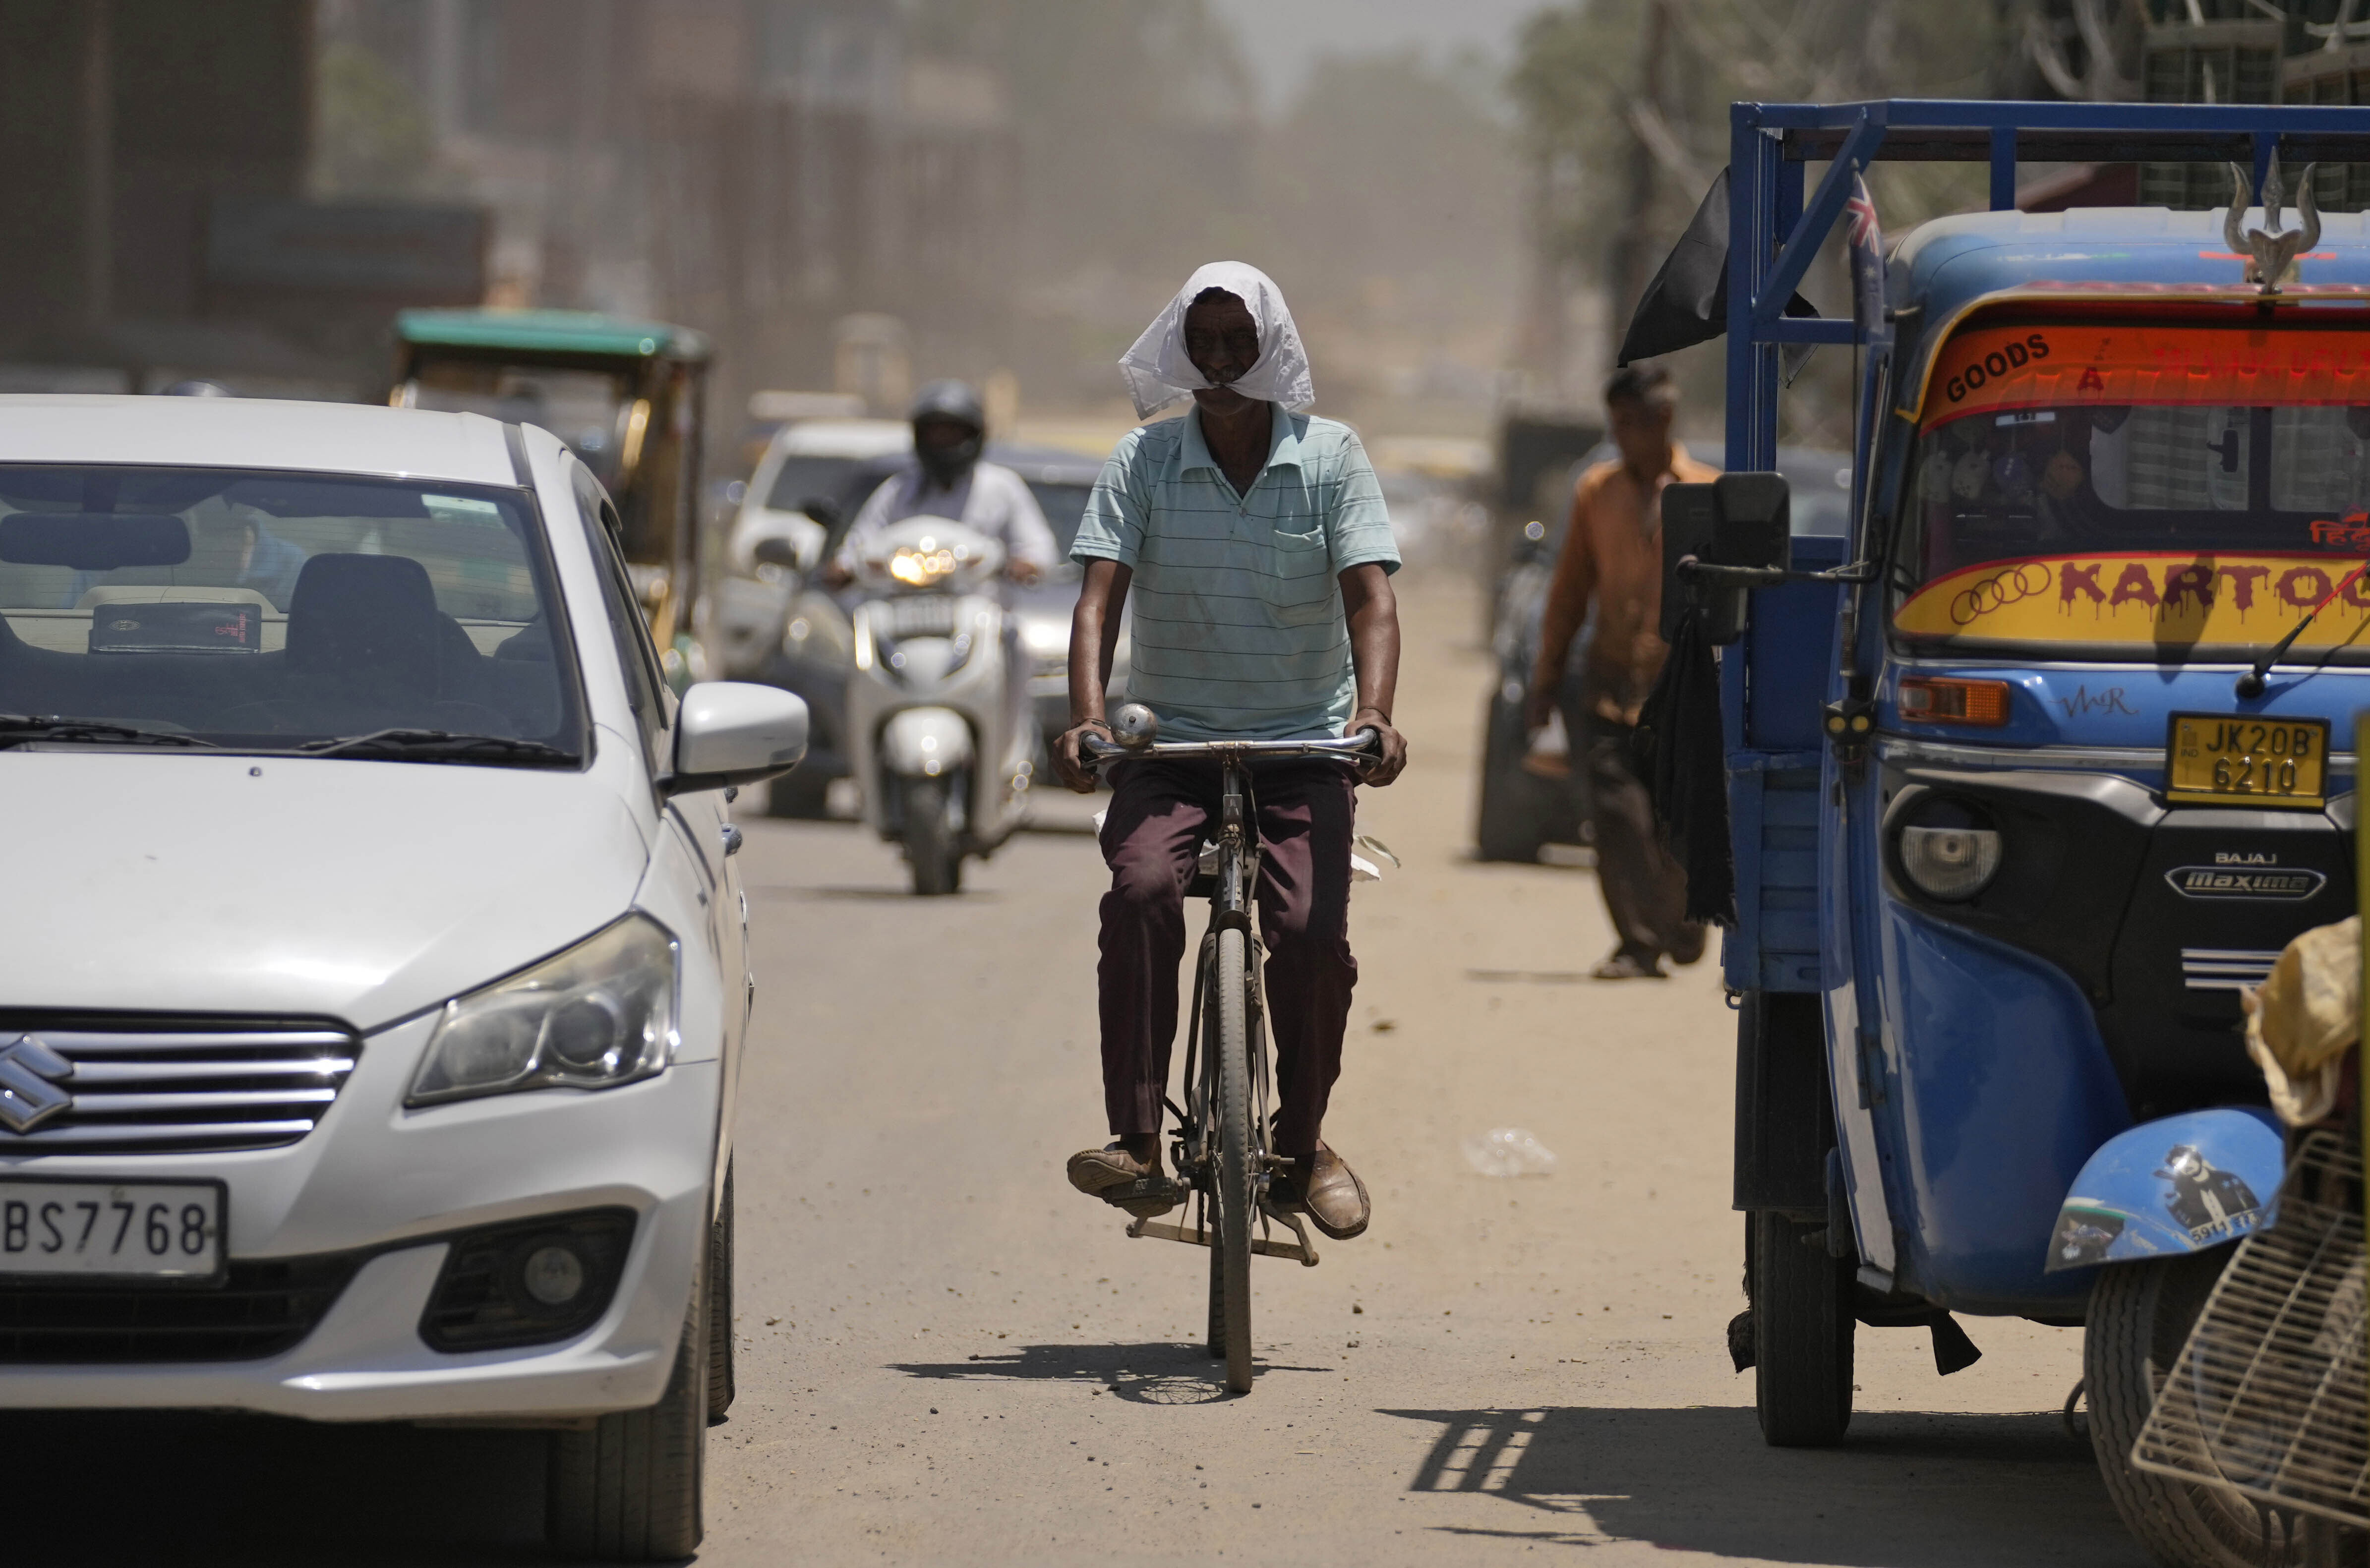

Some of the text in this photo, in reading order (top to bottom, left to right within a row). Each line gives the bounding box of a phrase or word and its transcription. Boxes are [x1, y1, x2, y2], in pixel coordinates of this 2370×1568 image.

[1947, 334, 2049, 403] GOODS
[2077, 366, 2104, 391] A
[2207, 723, 2311, 756] JK20B
[2214, 756, 2296, 790] 6210
[2215, 853, 2278, 864] BAJAJ
[4, 1200, 206, 1256] BS7768
